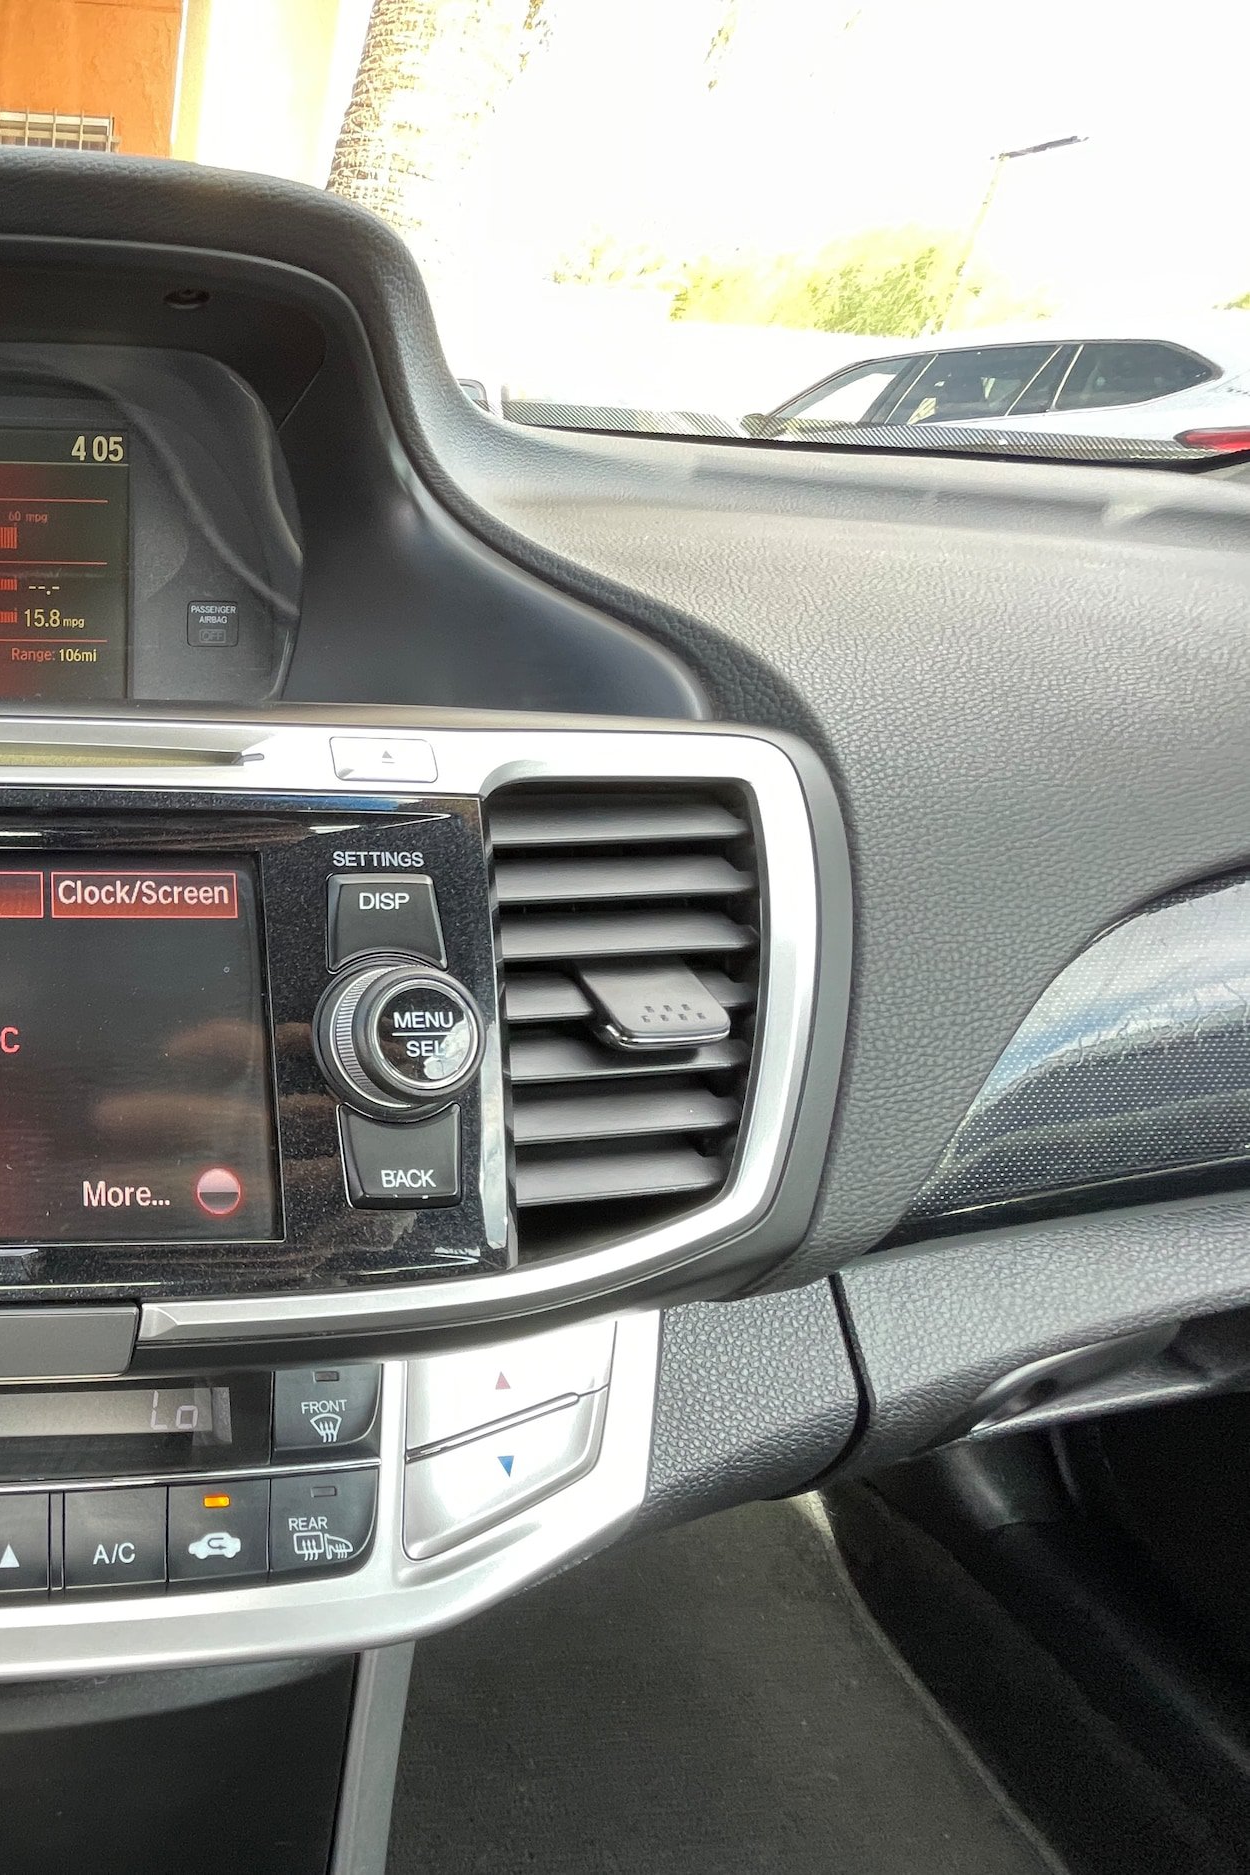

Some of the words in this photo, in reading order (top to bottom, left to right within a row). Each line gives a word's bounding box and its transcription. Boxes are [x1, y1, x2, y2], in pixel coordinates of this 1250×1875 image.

[8, 511, 21, 522] 60
[25, 512, 48, 523] mpg
[190, 605, 236, 614] PASSENGER
[198, 615, 228, 624] AIRBAG
[202, 631, 224, 641] OFF
[11, 647, 56, 663] Range:
[59, 648, 97, 662] 106mi
[332, 850, 425, 868] SETTINGS
[57, 880, 230, 906] Clock/Screen
[358, 891, 410, 911] DISP
[393, 1011, 454, 1029] MENU
[405, 1040, 447, 1058] SEL
[380, 1168, 437, 1189] BACK
[82, 1181, 171, 1209] More...
[301, 1400, 347, 1415] FRONT
[288, 1518, 328, 1530] REAR
[93, 1543, 136, 1565] A/C
